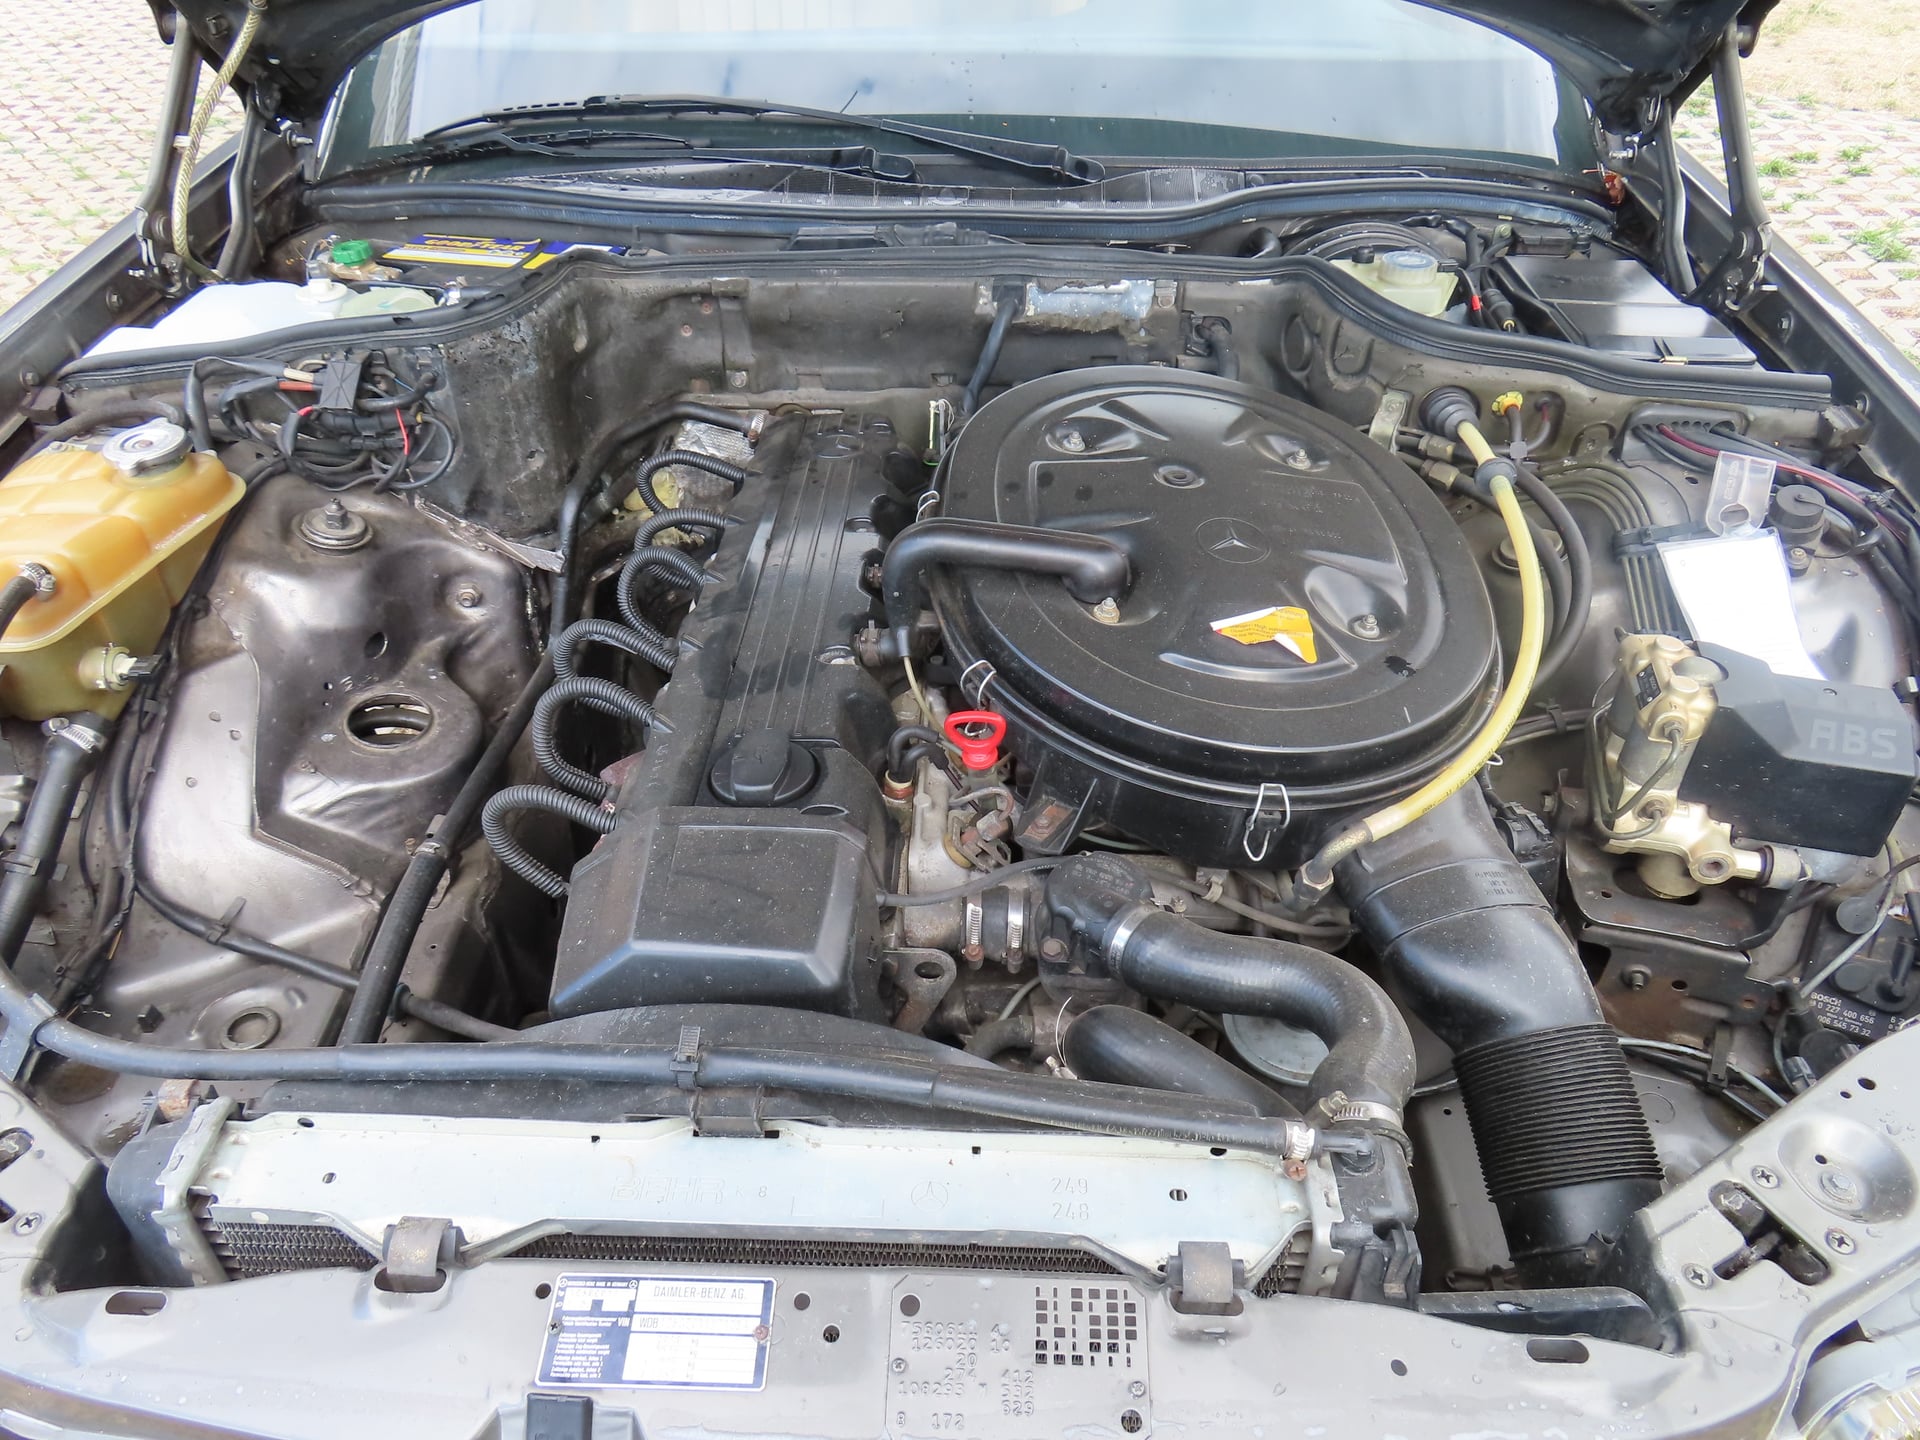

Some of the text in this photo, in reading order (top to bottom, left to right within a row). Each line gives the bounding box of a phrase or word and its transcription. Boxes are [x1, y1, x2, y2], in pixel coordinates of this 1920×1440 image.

[1808, 719, 1897, 760] ABS
[1811, 992, 1842, 1006] BOSCH
[1825, 1004, 1840, 1013] 227
[1843, 1010, 1858, 1019] 400
[1860, 1014, 1875, 1024] 656
[1860, 1028, 1871, 1037] 32
[758, 1185, 768, 1198] 8
[1050, 1176, 1088, 1194] 249
[1052, 1202, 1089, 1220] 248
[653, 1286, 745, 1300] DAIMLER-BENZ AG
[639, 1317, 659, 1329] WDB
[956, 1352, 978, 1369] 20
[931, 1412, 965, 1430] 172
